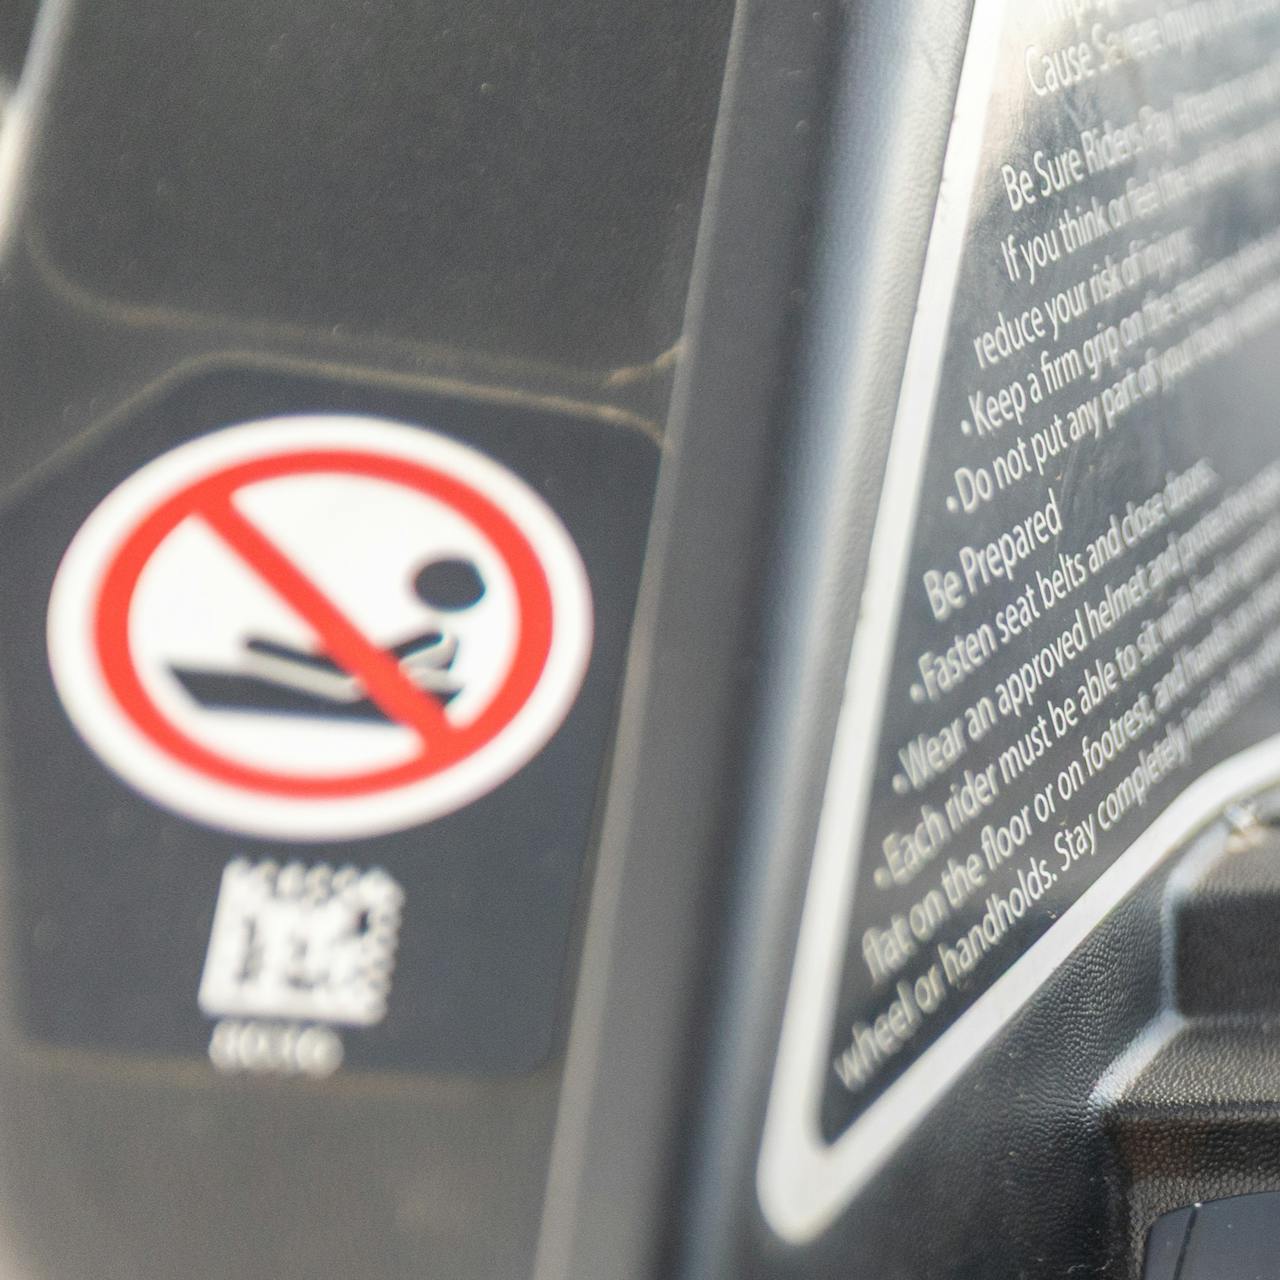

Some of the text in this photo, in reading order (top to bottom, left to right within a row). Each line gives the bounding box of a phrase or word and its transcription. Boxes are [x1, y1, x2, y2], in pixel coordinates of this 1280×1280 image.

[1025, 42, 1094, 96] Cause
[1000, 164, 1036, 212] Be
[1034, 147, 1085, 197] Sure
[1001, 234, 1020, 281] If
[1021, 226, 1060, 285] you
[1059, 196, 1110, 253] think
[968, 380, 1026, 436] Keep
[1027, 372, 1043, 403] a
[1040, 350, 1083, 394] firm
[1083, 322, 1119, 380] grip
[973, 312, 1046, 370] reduce
[1044, 274, 1089, 341] your
[1089, 254, 1121, 305] risk
[954, 467, 994, 513] Do
[992, 437, 1032, 489] not
[1031, 414, 1067, 476] put
[1067, 395, 1099, 438] any
[1101, 368, 1141, 429] part
[918, 624, 998, 700] Fasten
[996, 583, 1040, 645] seat
[1035, 553, 1086, 610] belts
[1086, 514, 1122, 574] and
[923, 570, 965, 621] Be
[959, 488, 1063, 596] Prepared
[898, 718, 967, 790] Wear
[965, 697, 998, 742] an
[995, 608, 1087, 717] approved
[1085, 564, 1151, 640] helmet
[882, 805, 949, 885] Each
[944, 763, 999, 833] rider
[999, 715, 1052, 784] must
[1048, 700, 1078, 738] be
[1078, 659, 1118, 715] able
[1115, 643, 1138, 681] to
[862, 914, 917, 988] flat
[909, 890, 948, 941] on
[941, 857, 986, 909] the
[981, 805, 1032, 872] floor
[1034, 783, 1056, 823] or
[1058, 761, 1086, 800] on
[834, 981, 922, 1092] wheel
[914, 964, 946, 1015] or
[938, 856, 1057, 986] handholds.
[1054, 814, 1095, 871] Stay
